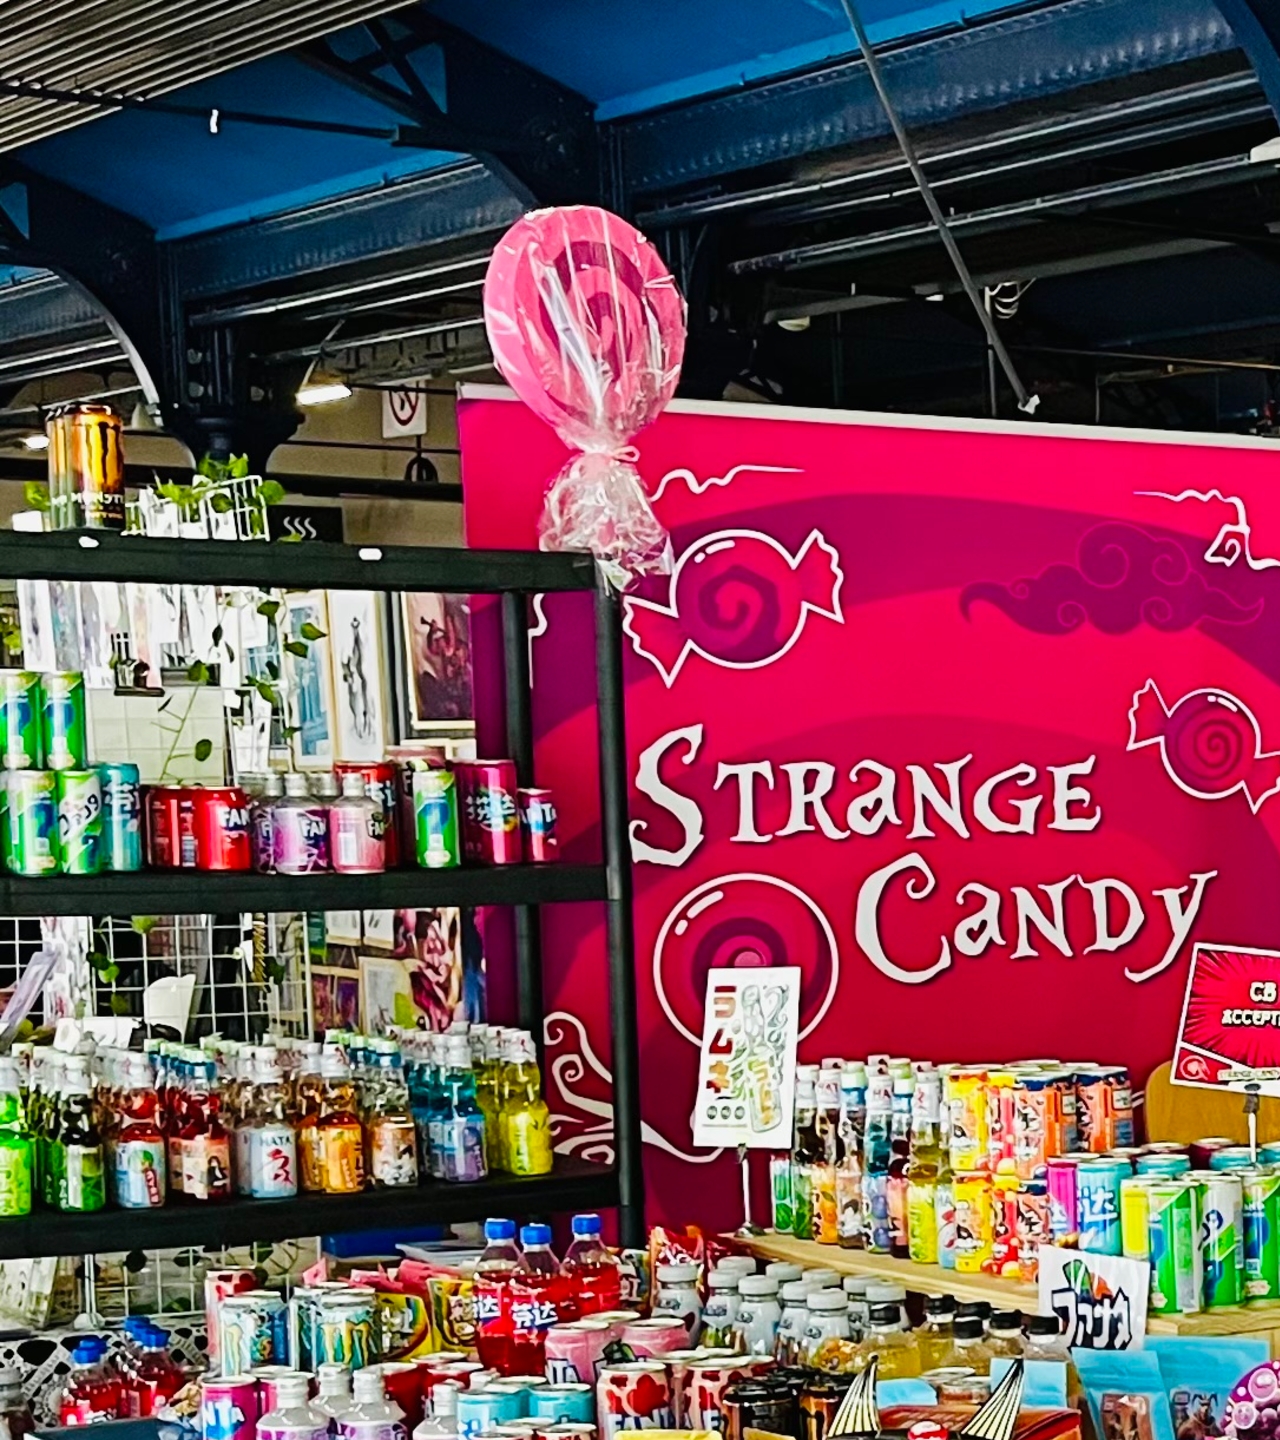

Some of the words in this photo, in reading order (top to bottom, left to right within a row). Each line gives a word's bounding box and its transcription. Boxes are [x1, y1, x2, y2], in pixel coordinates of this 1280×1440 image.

[629, 723, 1102, 867] STRANGE
[854, 852, 1218, 984] CANDY
[1250, 981, 1277, 1003] CB
